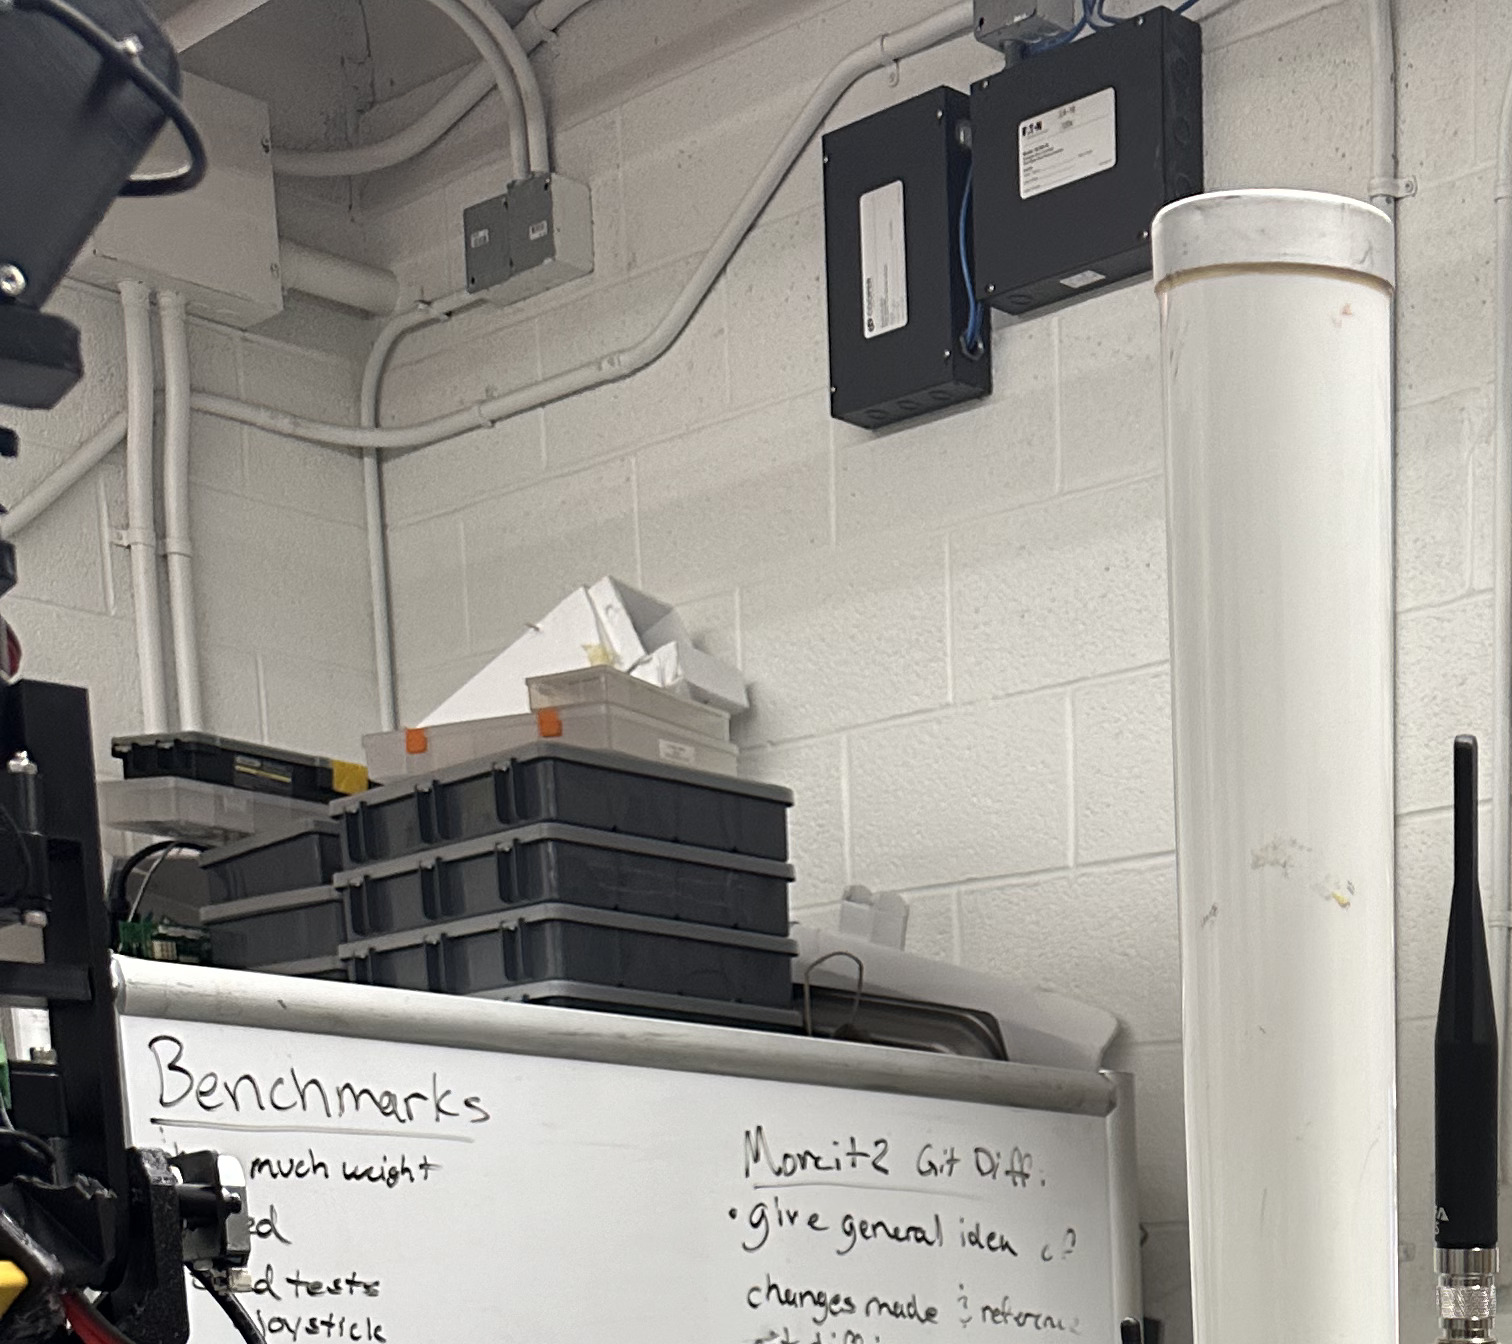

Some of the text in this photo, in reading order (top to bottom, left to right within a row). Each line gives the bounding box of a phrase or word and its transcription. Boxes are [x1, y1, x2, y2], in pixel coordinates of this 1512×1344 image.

[147, 1034, 493, 1125] Benchmarks
[250, 1146, 446, 1187] much weight
[915, 1143, 960, 1178] Git
[742, 1195, 830, 1253] give
[834, 1212, 944, 1256] general
[285, 1271, 383, 1299] tests
[746, 1271, 857, 1326] changes
[864, 1293, 940, 1325] made
